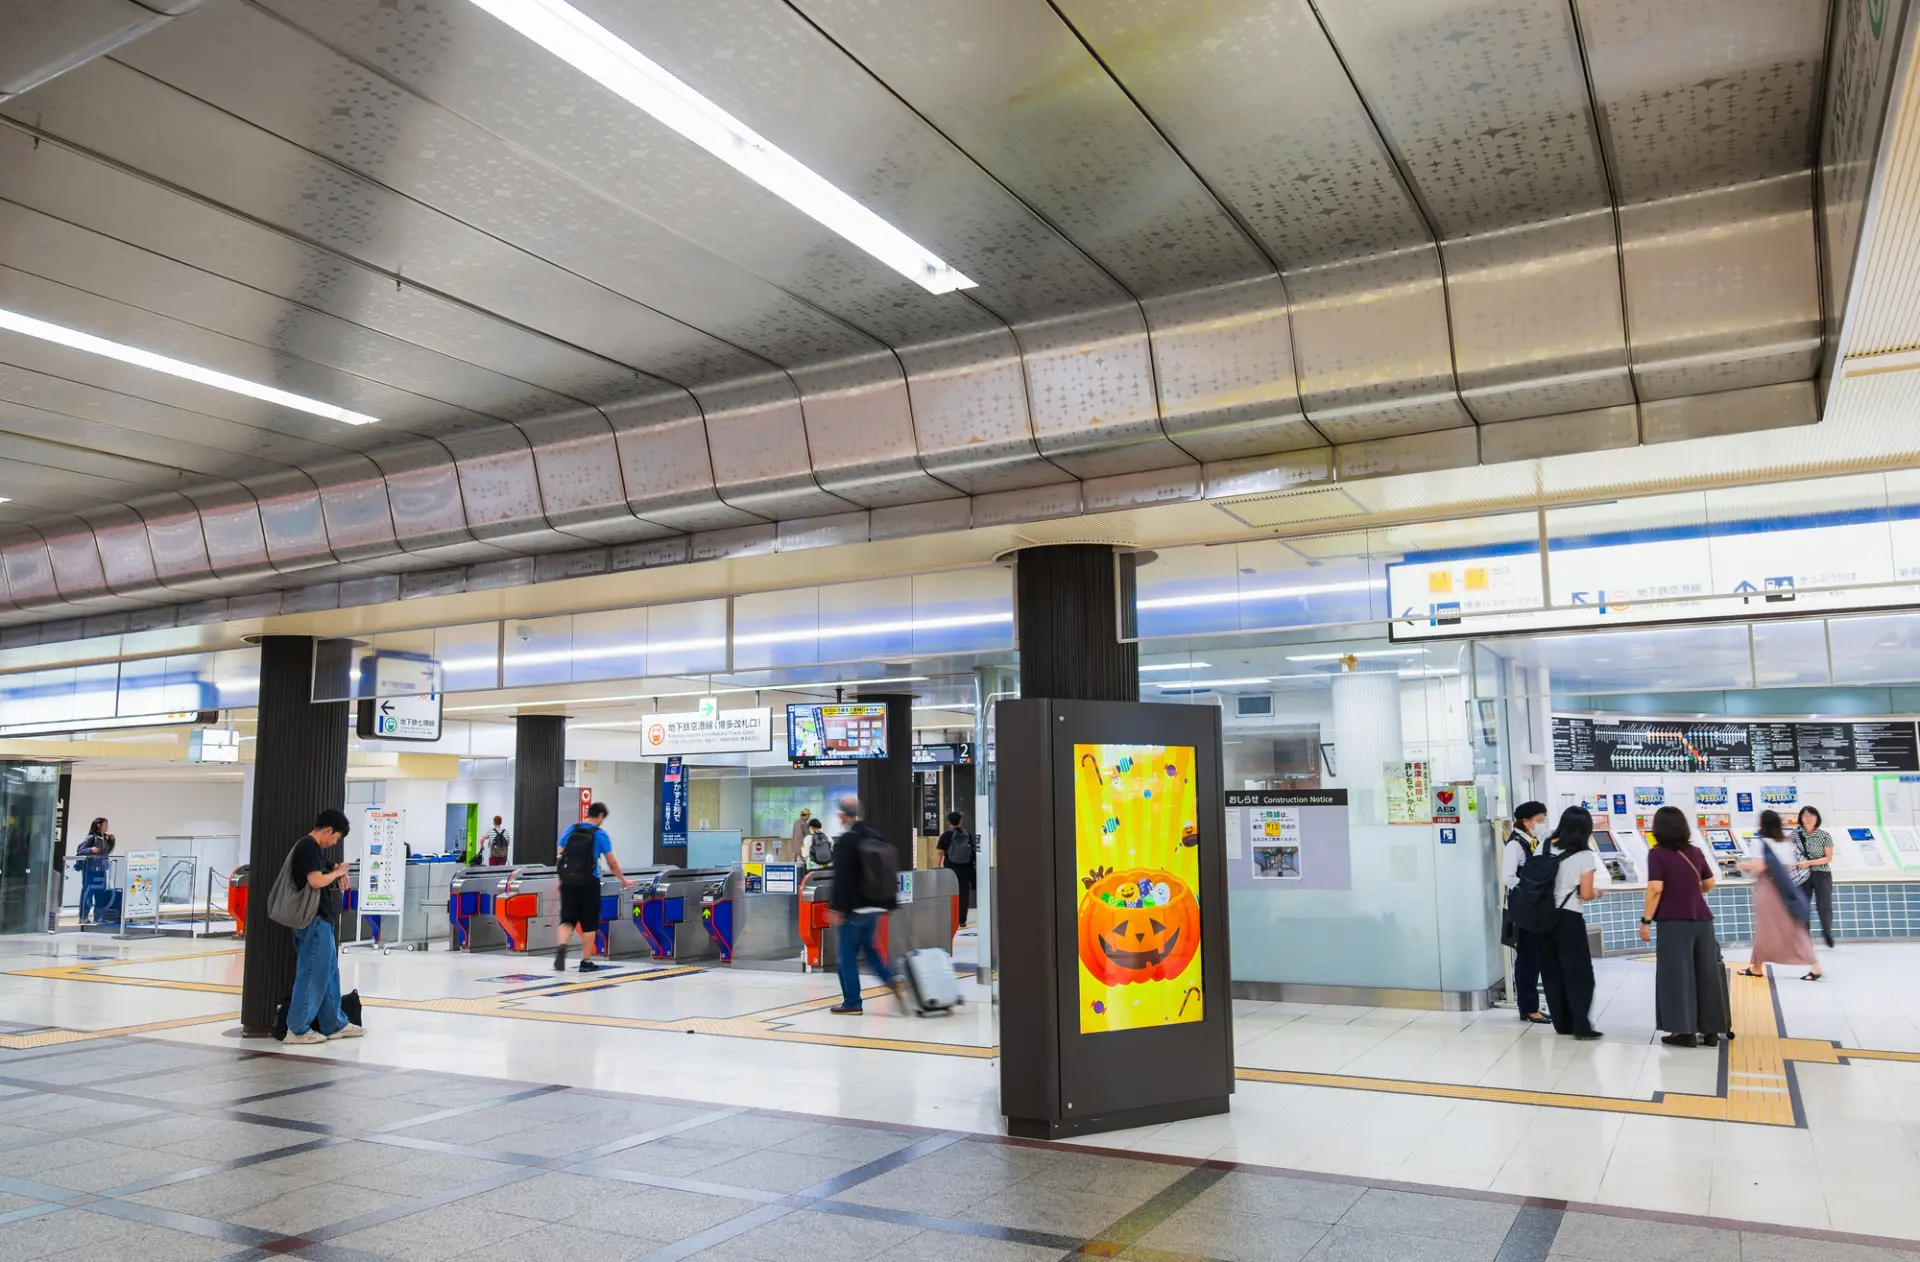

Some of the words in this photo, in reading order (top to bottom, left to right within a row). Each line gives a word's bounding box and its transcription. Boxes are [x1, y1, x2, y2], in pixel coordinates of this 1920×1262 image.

[960, 743, 969, 757] 2
[1228, 795, 1260, 804] おしらせ
[1263, 795, 1308, 804] Construction
[1309, 795, 1333, 803] Notice
